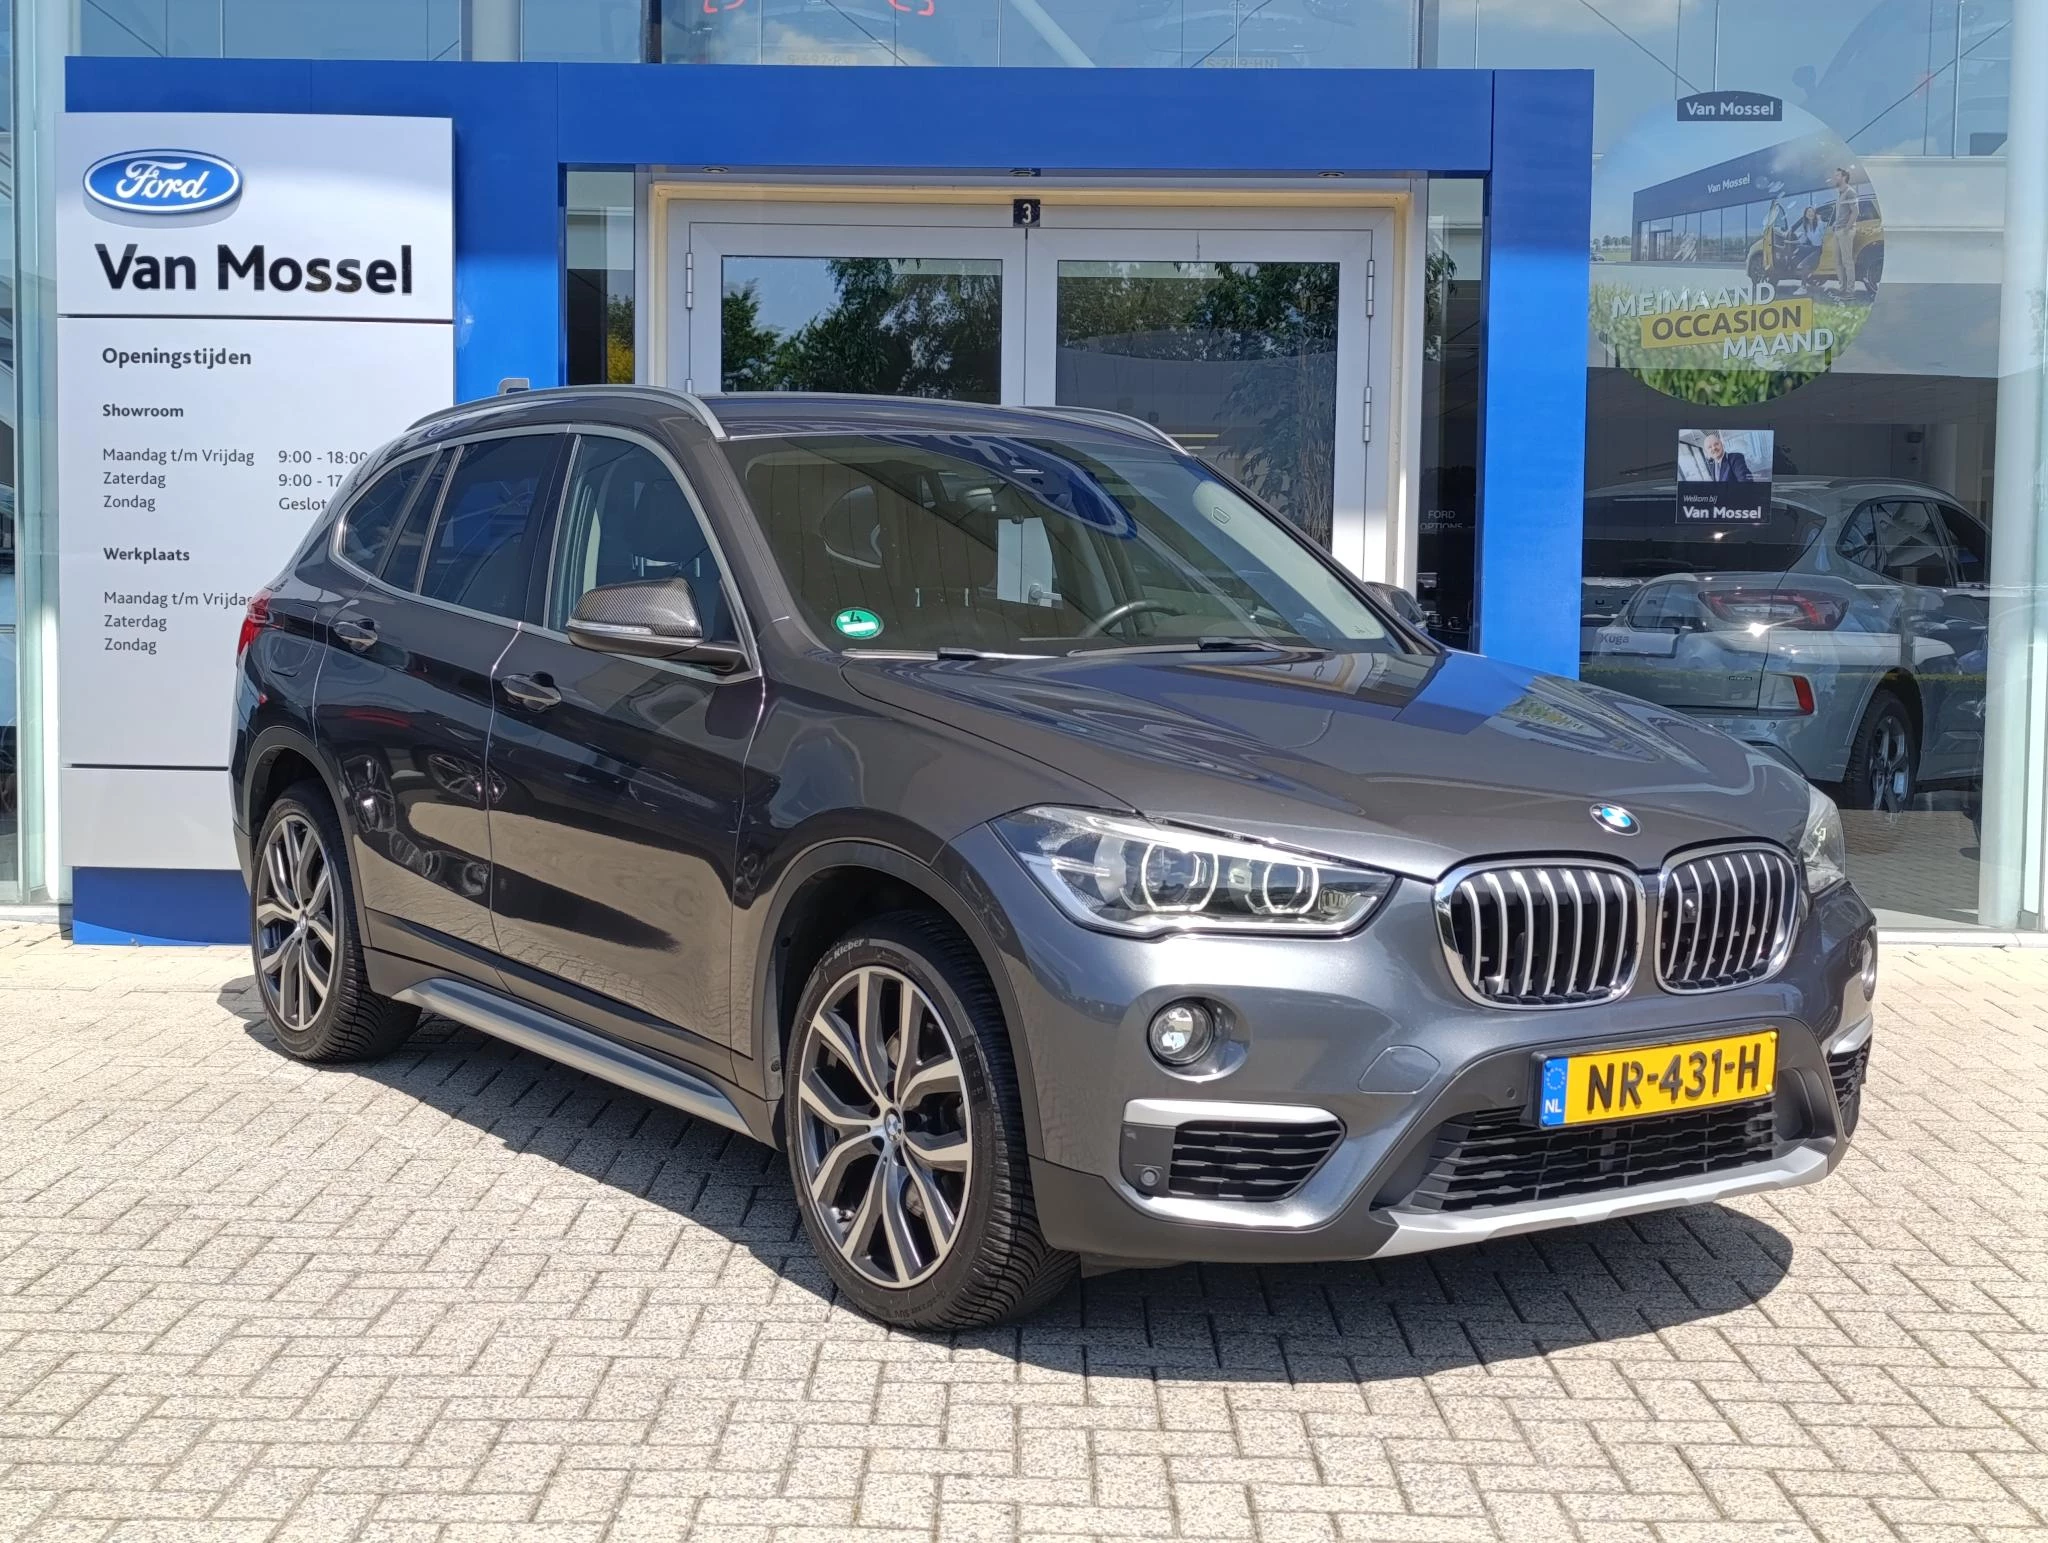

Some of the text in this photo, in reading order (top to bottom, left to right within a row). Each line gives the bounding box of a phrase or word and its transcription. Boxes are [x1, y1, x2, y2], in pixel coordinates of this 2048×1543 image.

[1686, 101, 1774, 116] Van Mossel
[115, 160, 210, 199] Ford
[1707, 172, 1751, 194] Van Mossel
[1022, 203, 1032, 224] 3
[94, 243, 413, 296] Van Mossel
[1652, 305, 1801, 340] OCCASION
[1723, 328, 1835, 360] MAAND
[102, 347, 252, 370] Openingstijden
[102, 403, 184, 418] Showroom
[103, 448, 255, 467] Maandag t/m Vrijdag
[278, 450, 312, 464] 9:00
[103, 471, 167, 489] Zaterdag
[278, 473, 312, 487] 9:00
[327, 474, 343, 488] 17
[103, 495, 156, 513] Zondag
[278, 497, 327, 511] Geslot
[1683, 495, 1709, 504] Welkom
[1428, 510, 1456, 519] FORD
[1683, 505, 1762, 519] Van Mossel
[103, 547, 190, 565] Werkplaats
[104, 592, 168, 608] Maandag
[172, 592, 199, 606] t/m
[104, 615, 167, 632] Zaterdag
[850, 611, 862, 623] 4
[104, 638, 157, 655] Zondag
[1545, 1043, 1762, 1114] NL NR-431-H
